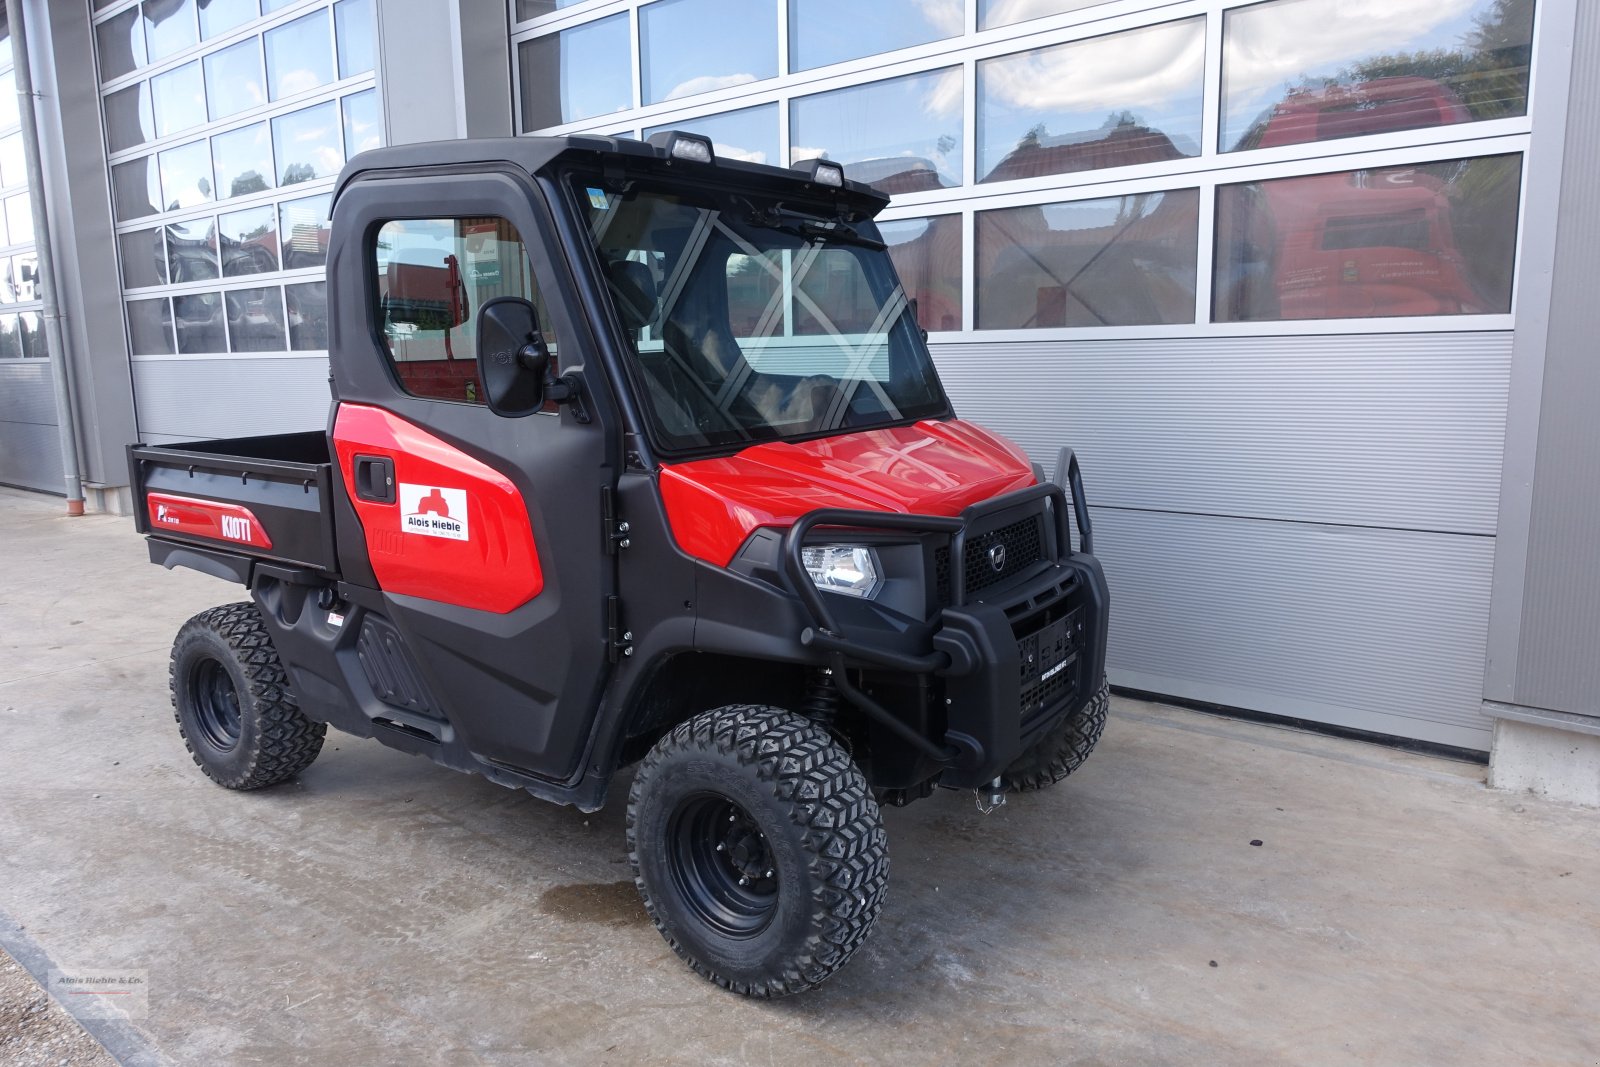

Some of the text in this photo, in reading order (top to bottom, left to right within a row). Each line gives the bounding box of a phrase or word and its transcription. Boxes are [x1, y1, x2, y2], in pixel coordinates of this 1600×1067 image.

[221, 515, 251, 541] KIOTI
[408, 517, 461, 532] Alois Hieble
